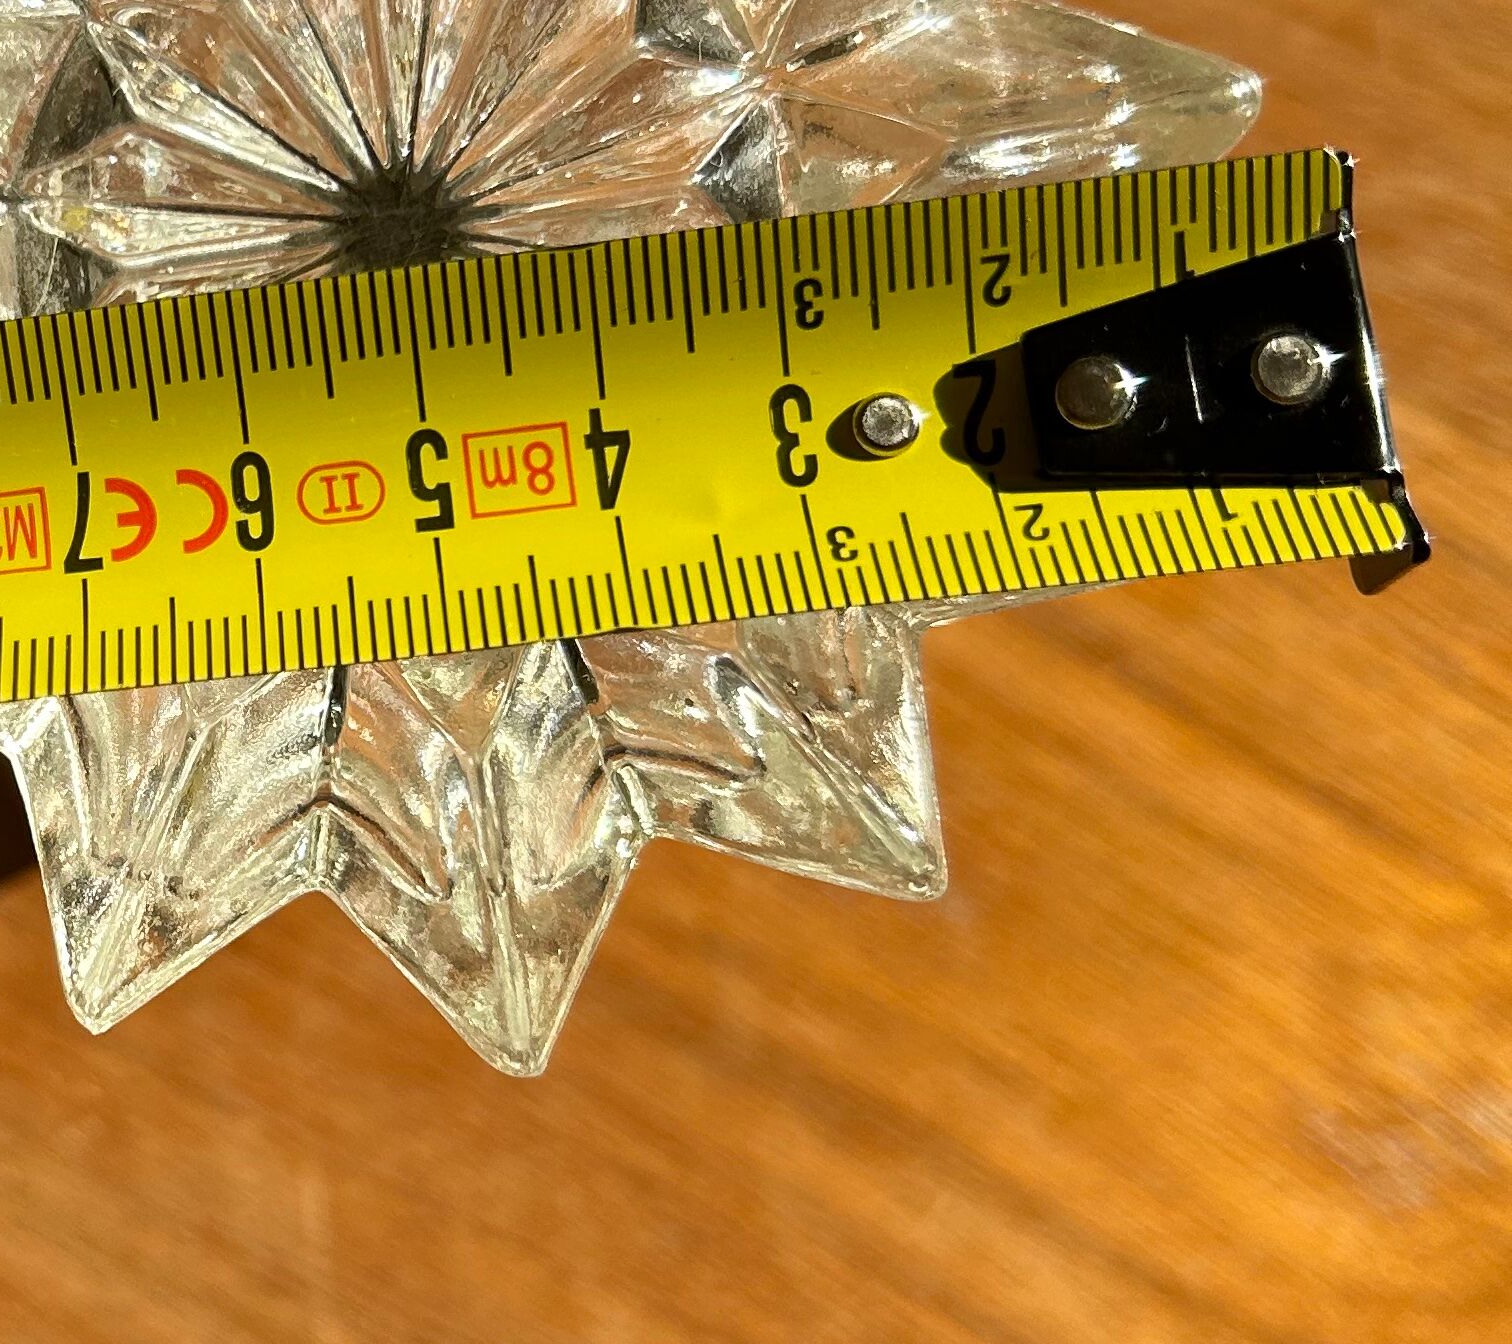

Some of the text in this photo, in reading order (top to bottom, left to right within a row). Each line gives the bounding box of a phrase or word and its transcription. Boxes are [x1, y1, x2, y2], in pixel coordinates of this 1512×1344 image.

[792, 278, 824, 330] 3
[980, 255, 1013, 307] 2
[584, 407, 631, 510] 4
[768, 385, 819, 487] 3
[952, 359, 1006, 466] 2
[230, 451, 275, 552] 6
[406, 428, 455, 533] 5
[480, 440, 555, 495] 8m
[63, 471, 104, 574] 7
[826, 525, 858, 562] 3
[1013, 504, 1050, 542] 2
